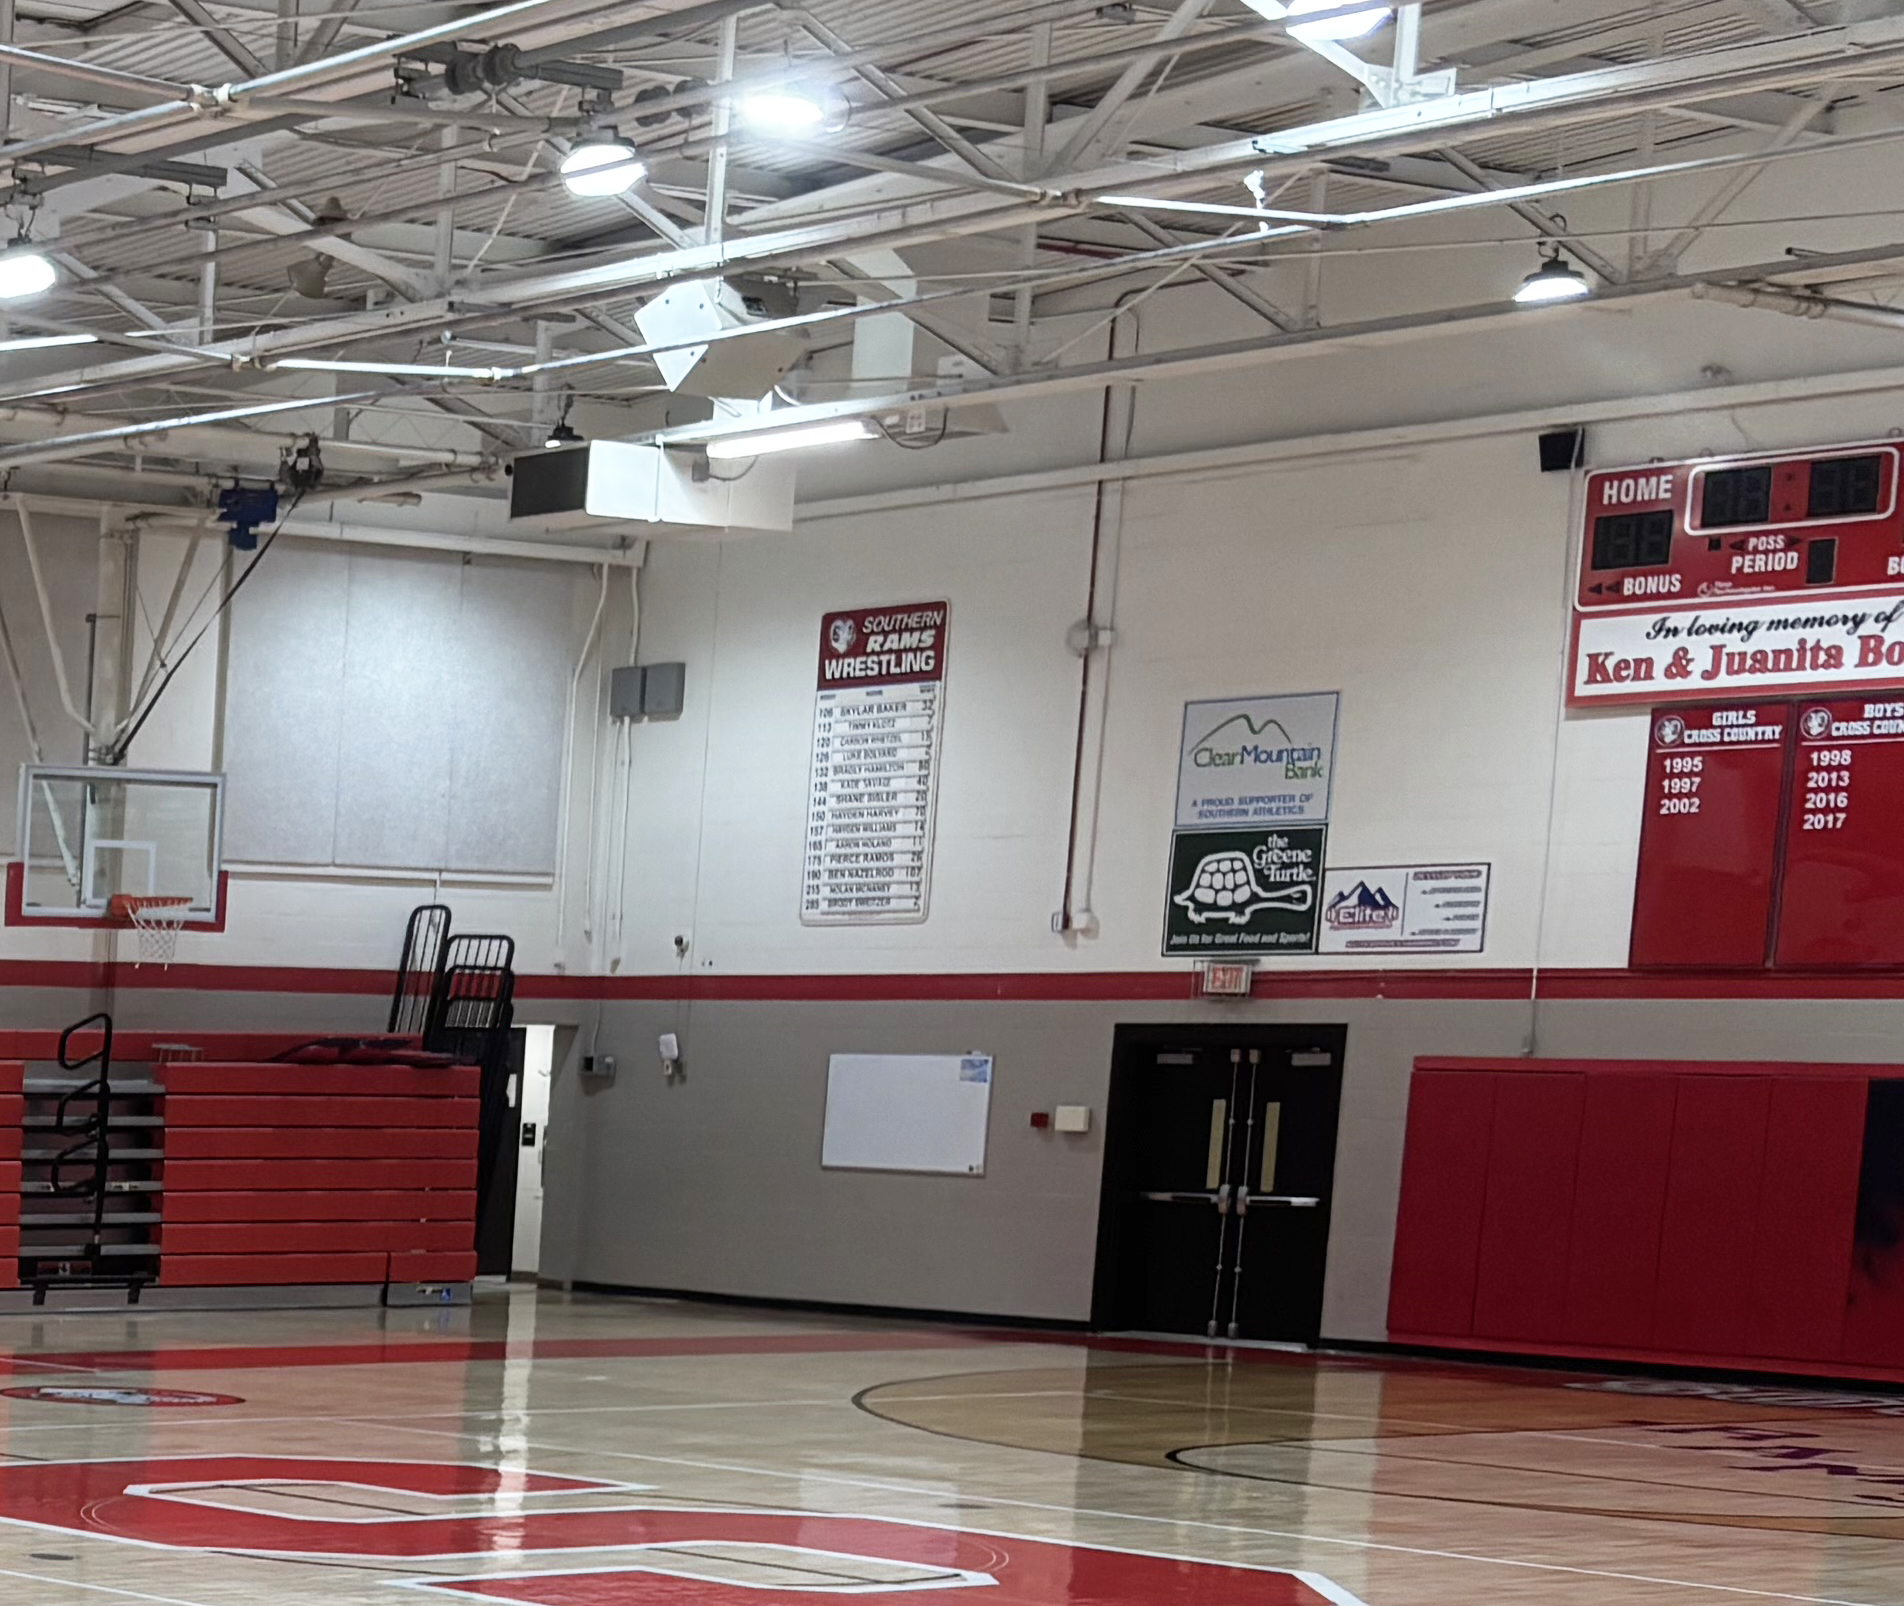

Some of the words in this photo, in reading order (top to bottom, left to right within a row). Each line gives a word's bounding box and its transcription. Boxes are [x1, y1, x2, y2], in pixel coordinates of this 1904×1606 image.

[1602, 474, 1674, 505] HOME
[1748, 534, 1785, 551] POSS
[1731, 551, 1800, 575] PERIOD
[1623, 573, 1683, 597] BONUS
[862, 609, 944, 634] SOUTHERN
[1687, 614, 1763, 643] loving
[1766, 609, 1868, 637] memory
[866, 629, 936, 653] RAMS
[824, 649, 936, 681] WRESTLING
[1583, 650, 1656, 687] Ken
[1663, 645, 1694, 681] &
[1701, 637, 1845, 682] Juanita
[1712, 709, 1757, 726] GIRLS
[1683, 726, 1722, 744] CROSS
[1723, 724, 1783, 742] COUNTRY
[1831, 720, 1871, 738] CROSS
[1663, 756, 1704, 774] 1995
[1809, 749, 1852, 767] 1998
[1284, 763, 1323, 780] Bank
[1806, 770, 1850, 788] 2013
[1661, 777, 1702, 794] 1997
[1201, 796, 1235, 808] PROUD
[1237, 793, 1296, 807] SUPPORTER
[1299, 792, 1314, 804] OF
[1659, 798, 1701, 815] 2002
[1804, 792, 1849, 809] 2016
[1197, 806, 1250, 820] SOUTHERN
[1252, 804, 1305, 818] ATHLETICS
[1802, 813, 1848, 830] 2017
[1267, 833, 1289, 849] the
[1252, 845, 1313, 869] Greene
[1339, 908, 1386, 923] Elite
